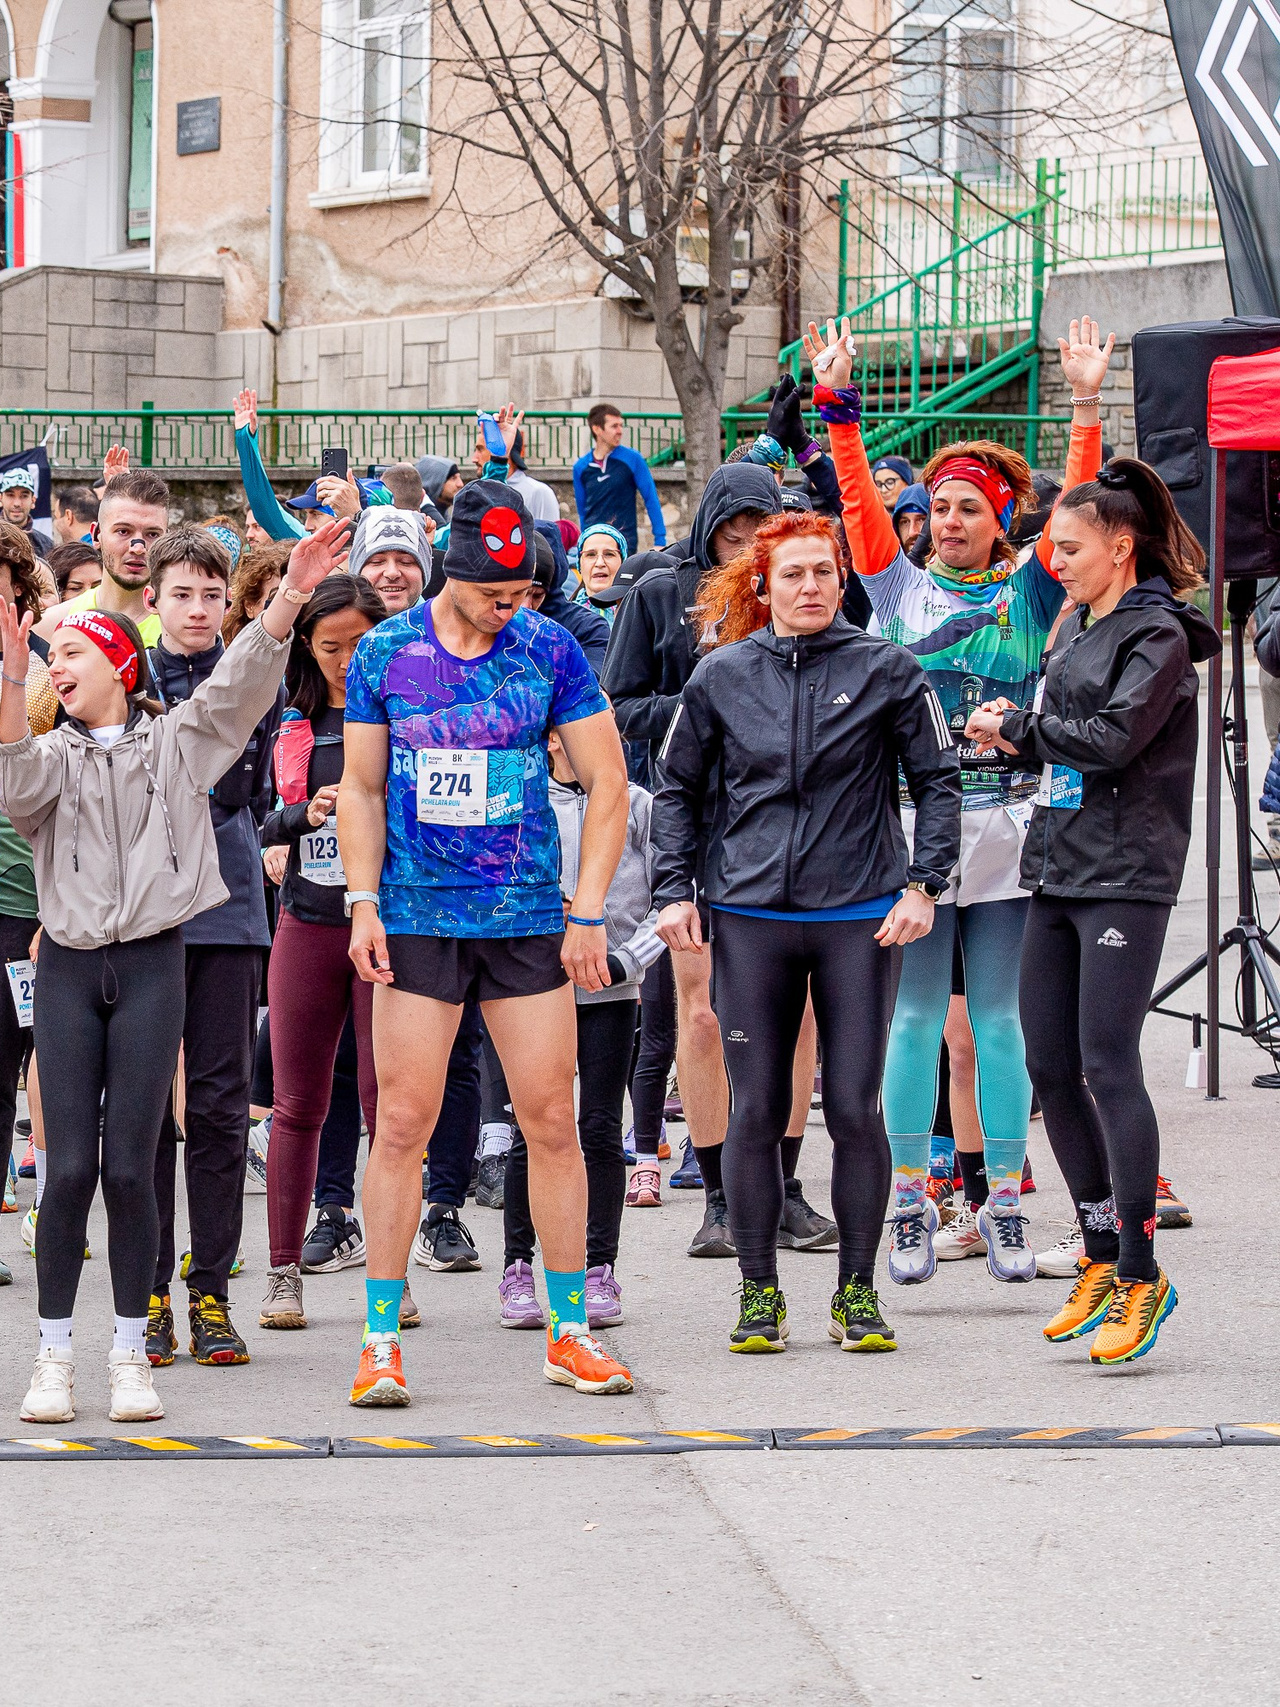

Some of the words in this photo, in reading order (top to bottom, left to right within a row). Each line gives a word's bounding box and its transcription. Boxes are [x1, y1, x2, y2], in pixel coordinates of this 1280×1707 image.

[452, 753, 463, 762] 8K
[429, 771, 472, 797] 274
[1051, 783, 1067, 794] STEP
[420, 798, 448, 806] PCHELATA
[448, 799, 460, 807] RUN
[486, 800, 506, 813] STEP
[488, 801, 524, 820] MATTERS
[306, 836, 338, 860] 123
